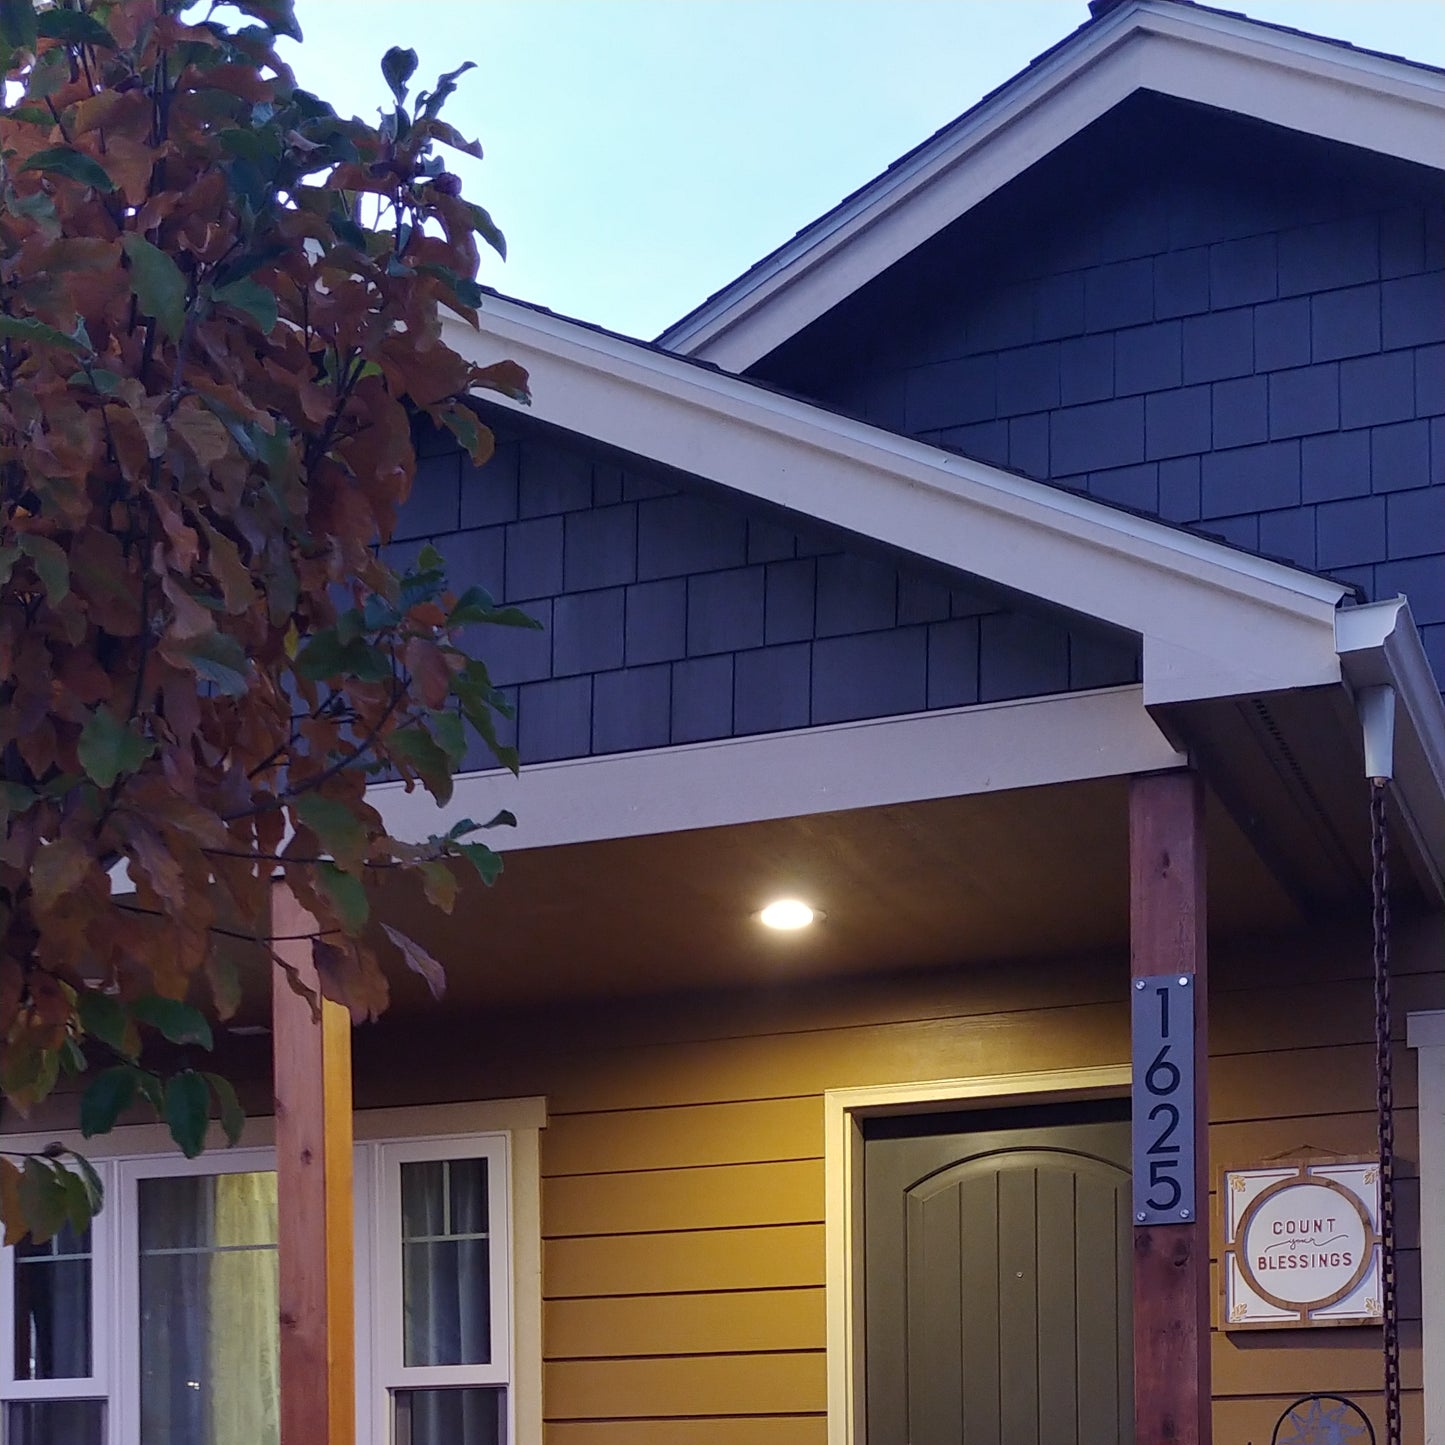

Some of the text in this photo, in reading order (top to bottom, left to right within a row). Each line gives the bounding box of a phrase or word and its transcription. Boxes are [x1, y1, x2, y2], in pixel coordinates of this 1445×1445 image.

[1145, 987, 1182, 1211] 1625
[1272, 1218, 1336, 1235] COUNT
[1258, 1252, 1352, 1270] BLESSINGS
